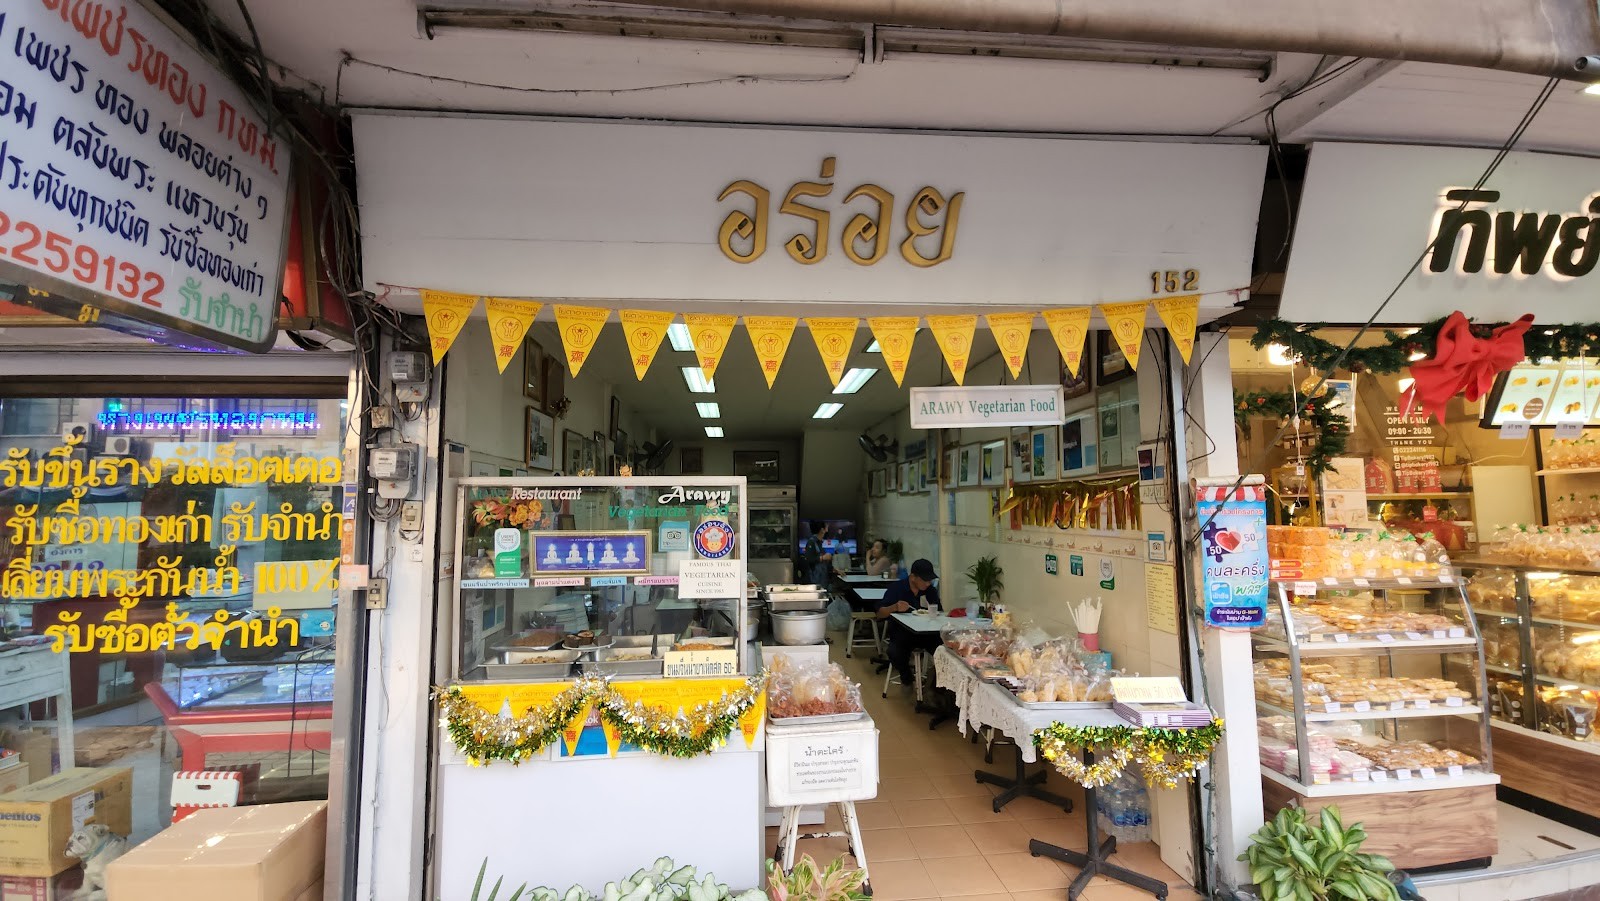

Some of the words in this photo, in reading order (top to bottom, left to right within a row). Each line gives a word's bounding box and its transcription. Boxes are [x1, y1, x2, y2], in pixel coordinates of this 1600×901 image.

[15, 26, 90, 94] เพชร
[95, 79, 149, 135] ทอง
[218, 99, 279, 176] กทม.
[53, 116, 155, 193] ตลับพระ
[166, 181, 249, 251] แหวนรุ่น
[716, 156, 966, 269] อร่อย
[159, 222, 265, 297] รับซื้อทองเก่า
[1150, 268, 1201, 294] 152
[178, 275, 265, 342] รับจำนำ
[919, 400, 965, 416] ARAWY
[968, 398, 1026, 418] Vegetarian
[1029, 396, 1056, 412] Food
[1386, 416, 1408, 425] OPEN
[0, 433, 345, 487] รับขึ้นรางวัลล็อตเตอ
[6, 486, 212, 546] รับซื้อทองเก่า
[221, 501, 343, 543] รับจำนำ
[511, 487, 583, 501] Restaurant
[657, 485, 732, 505] Arawy
[1209, 546, 1222, 555] 50
[1243, 532, 1256, 543] 50
[1, 544, 240, 599] เลี่ยมพระกันน้ำ
[256, 557, 340, 595] 100%
[1206, 558, 1265, 577] คนละครึ่ง
[44, 597, 299, 655] รับซื้อตั๋วจำนำ
[804, 745, 844, 757] น้ำตะไคร้
